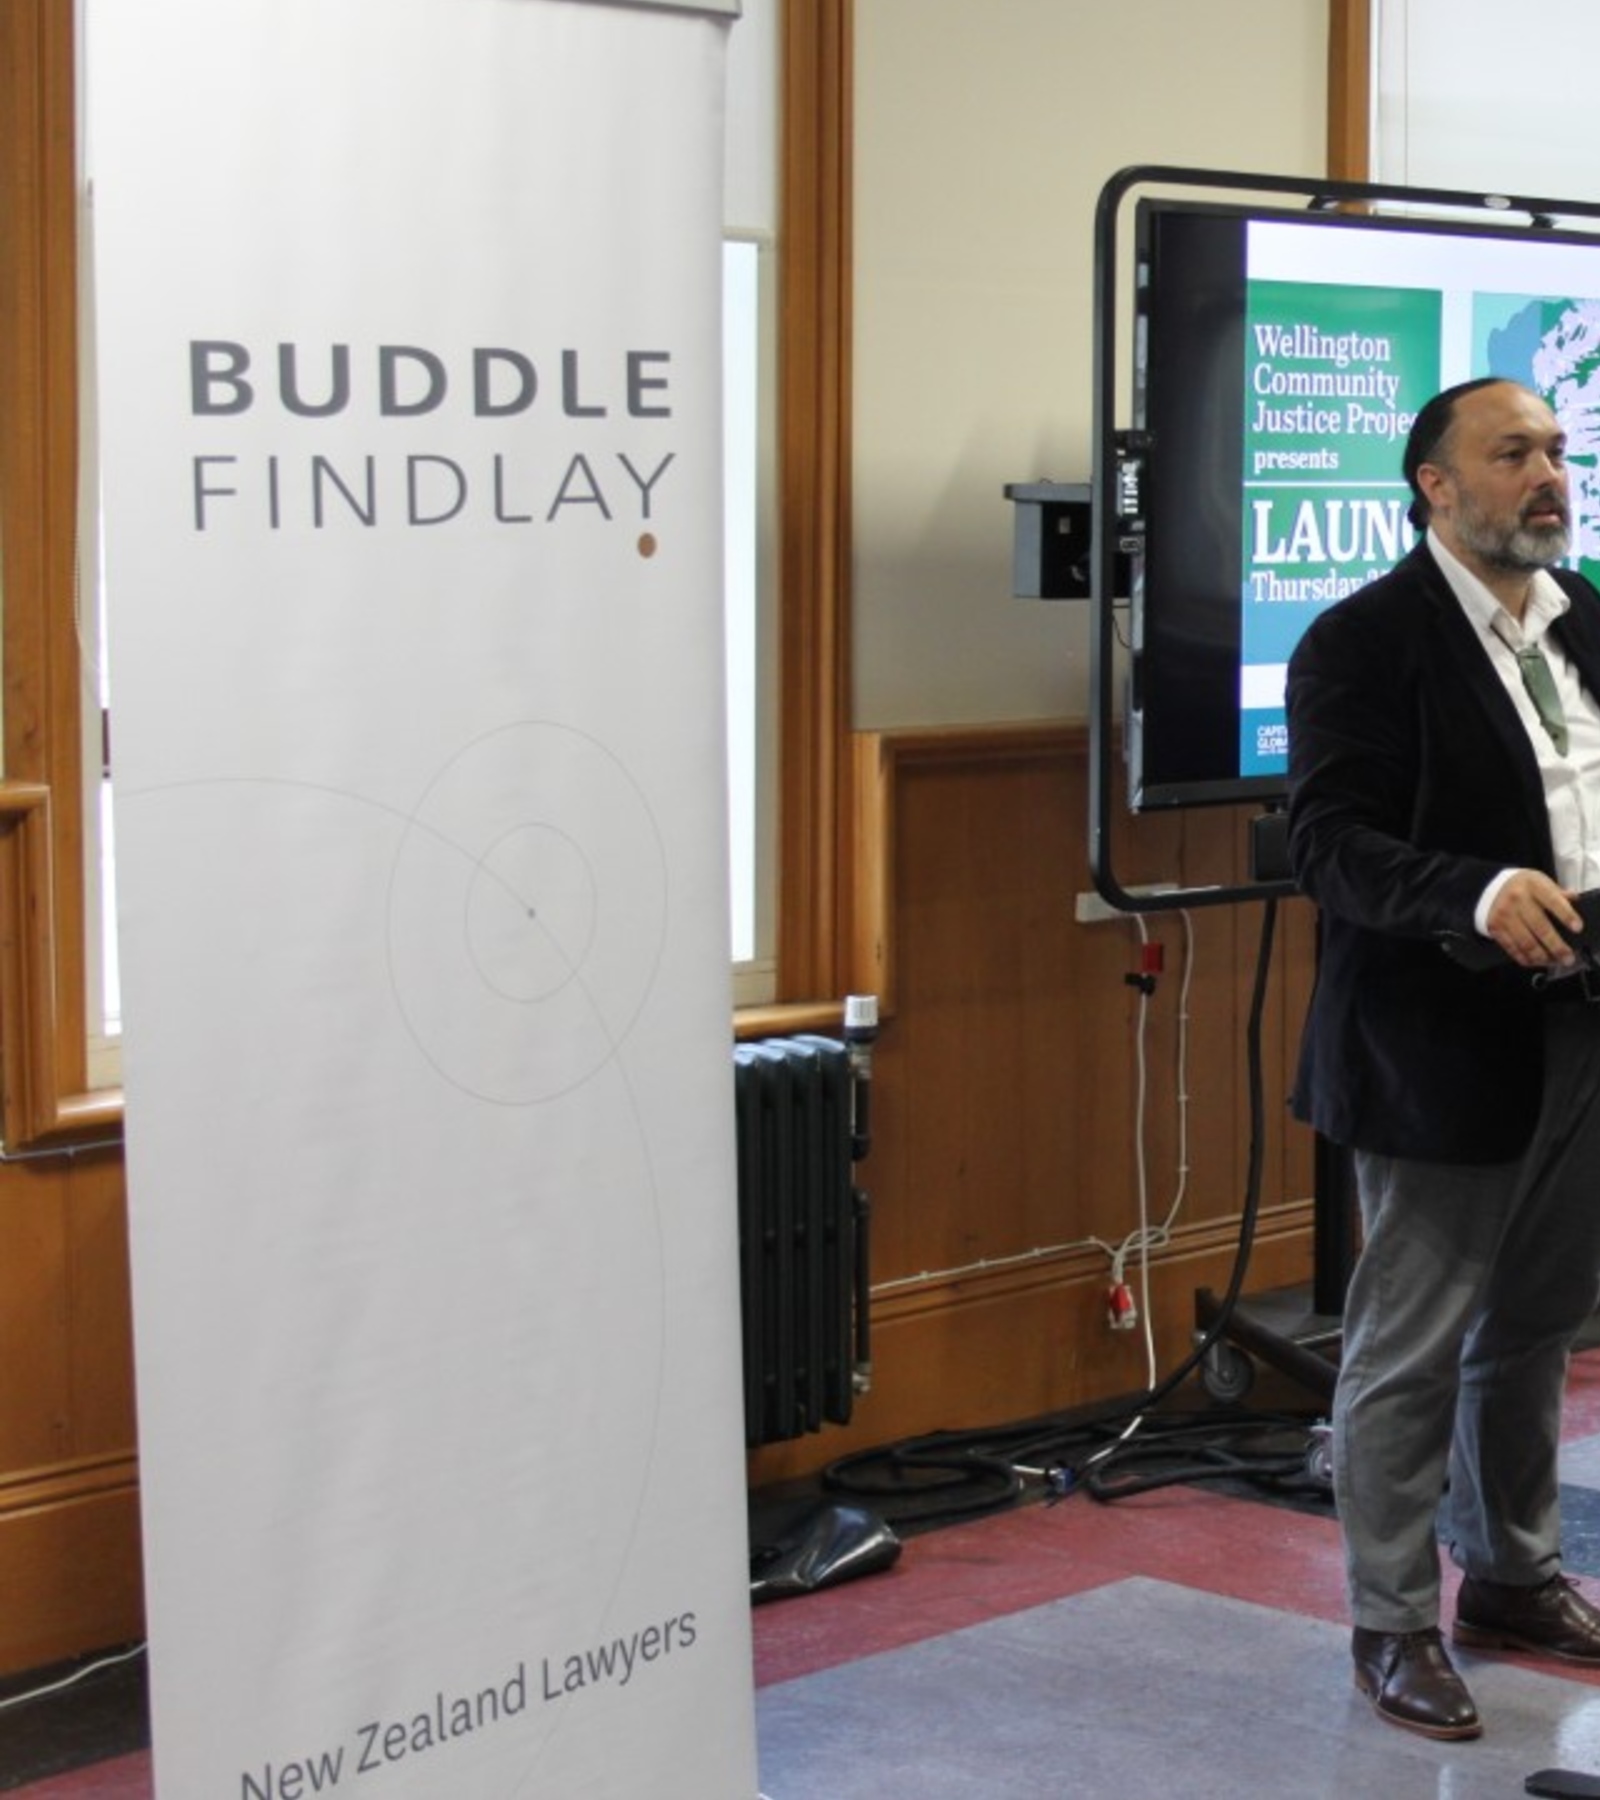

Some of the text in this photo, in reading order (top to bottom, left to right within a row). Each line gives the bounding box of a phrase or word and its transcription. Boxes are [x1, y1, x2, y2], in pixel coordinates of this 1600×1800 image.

[1254, 324, 1391, 368] Wellington
[188, 340, 671, 418] BUDDLE
[1254, 363, 1400, 410] Community
[1253, 400, 1341, 434] Justice
[1254, 448, 1339, 475] presents
[193, 452, 677, 531] FINDLAY
[241, 1612, 697, 1800] New Zealand Lawyers
